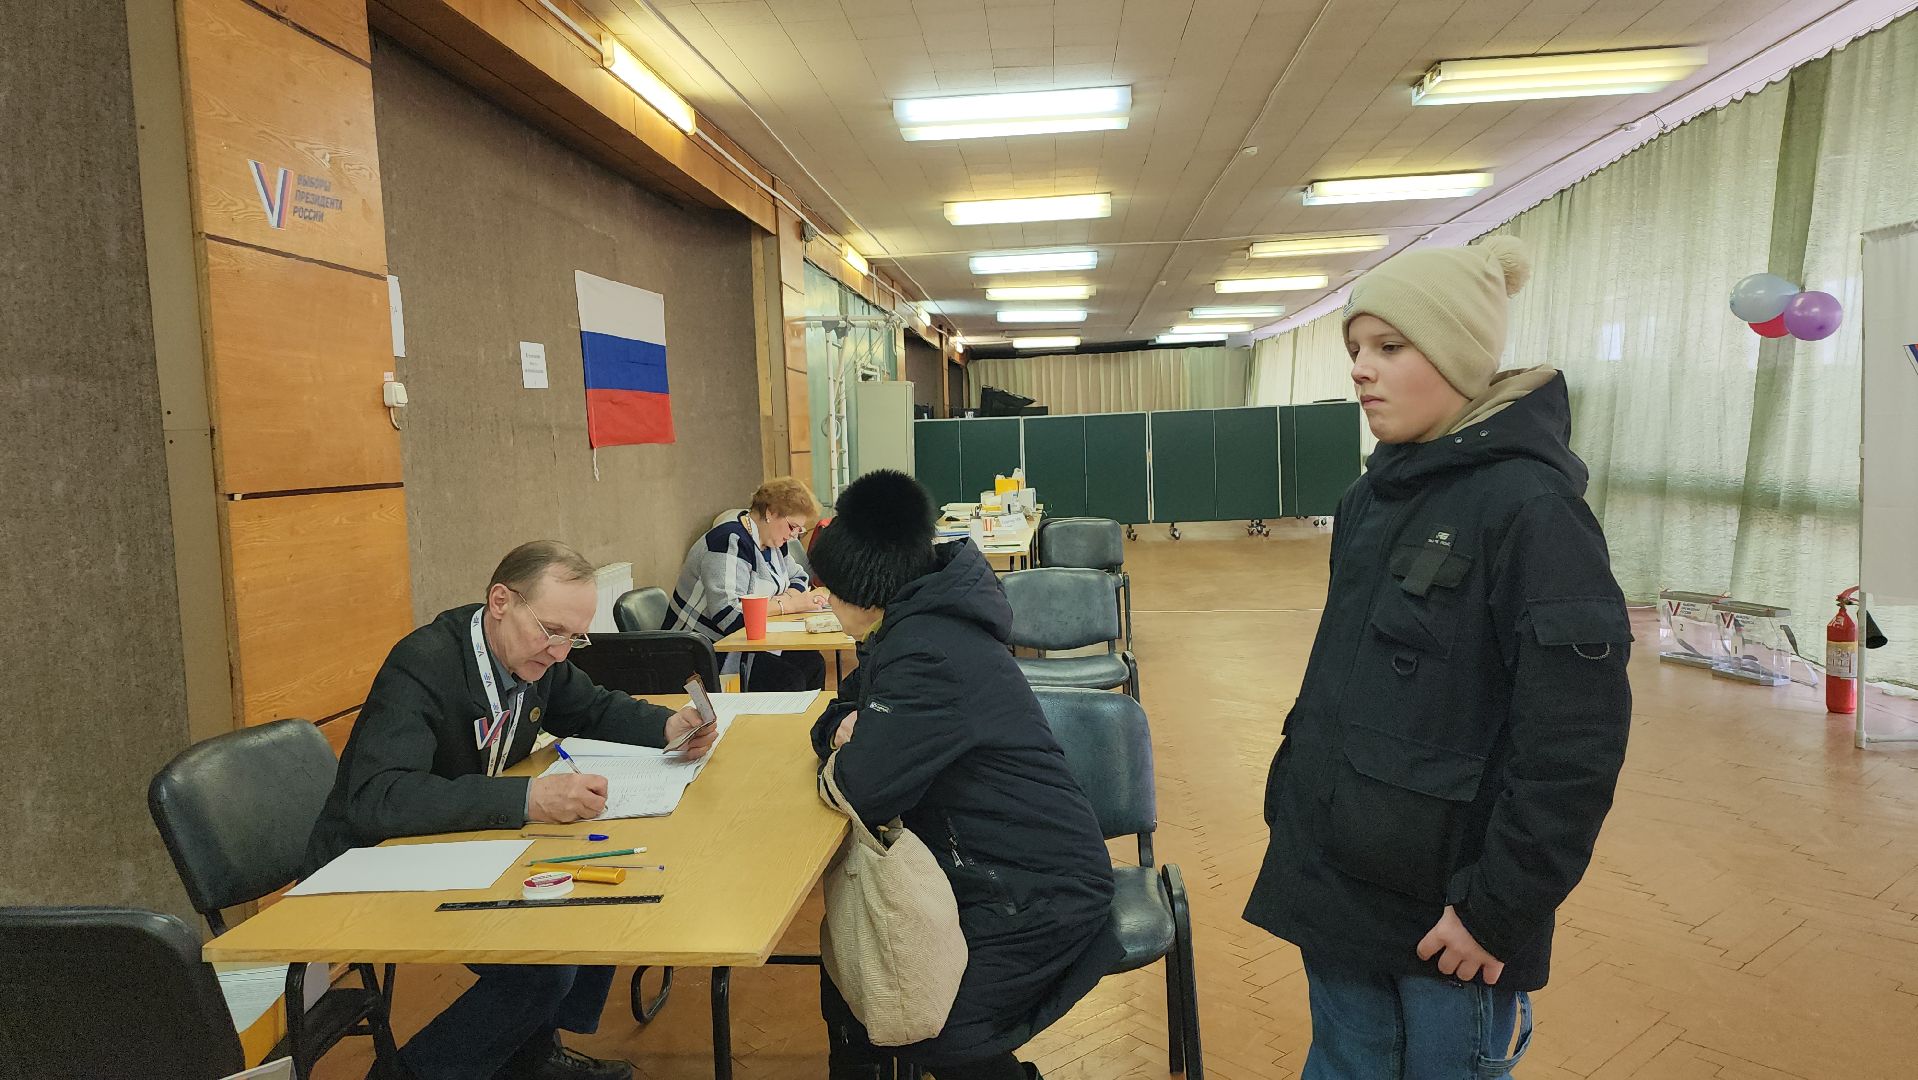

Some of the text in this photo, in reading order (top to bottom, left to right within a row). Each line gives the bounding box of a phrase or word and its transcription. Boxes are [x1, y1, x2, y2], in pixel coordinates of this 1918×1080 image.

[297, 174, 332, 192] ВЫБОРЫ
[295, 189, 343, 212] ПРЕЗИДЕНТА
[292, 205, 325, 223] РОССИИ
